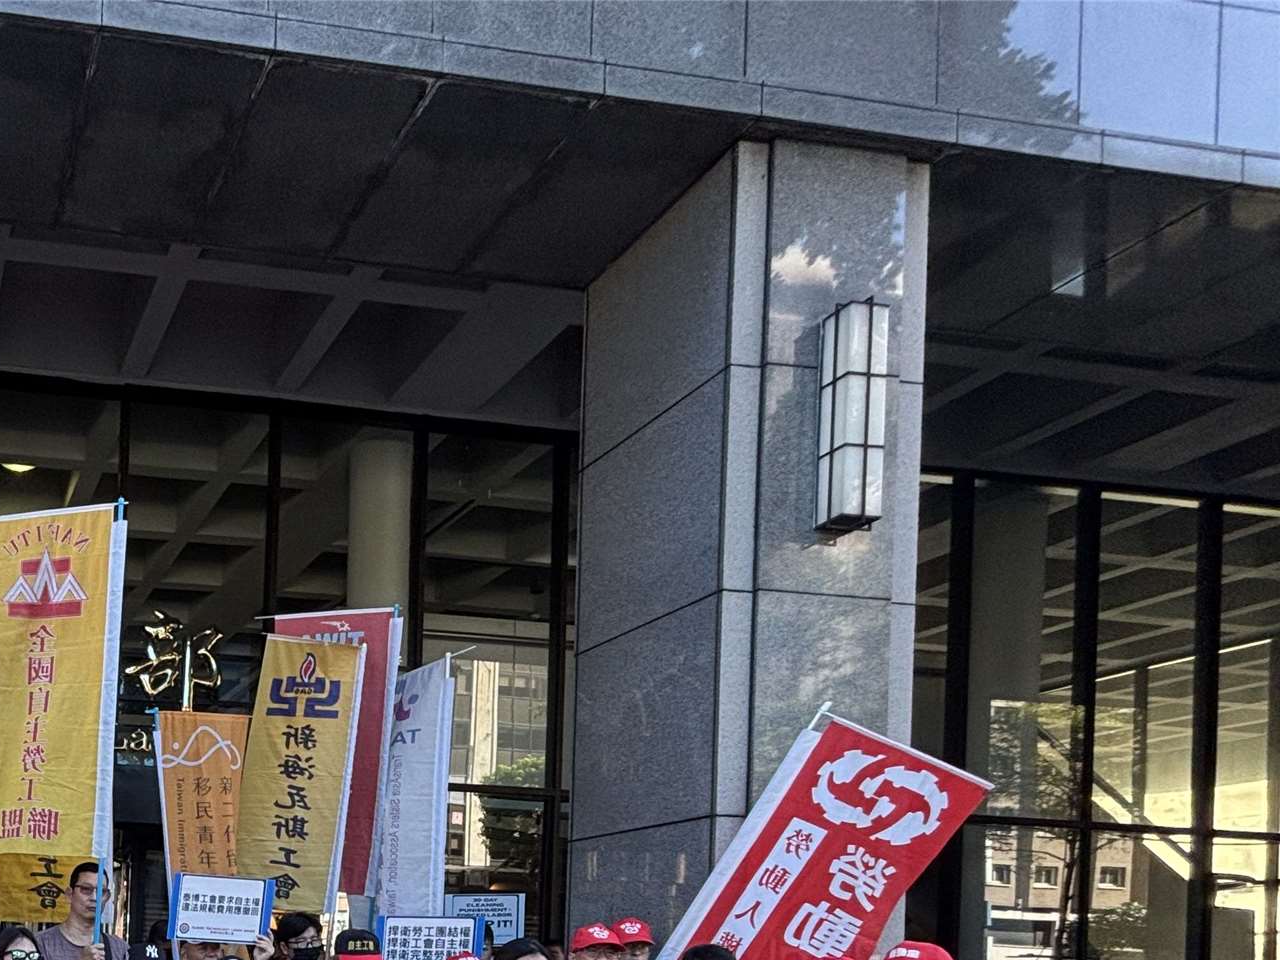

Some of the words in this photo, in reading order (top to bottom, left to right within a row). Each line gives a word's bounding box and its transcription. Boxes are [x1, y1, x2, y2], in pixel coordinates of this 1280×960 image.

[176, 778, 186, 815] Taiwan
[192, 776, 219, 869] 移民青年
[145, 943, 159, 958] NY
